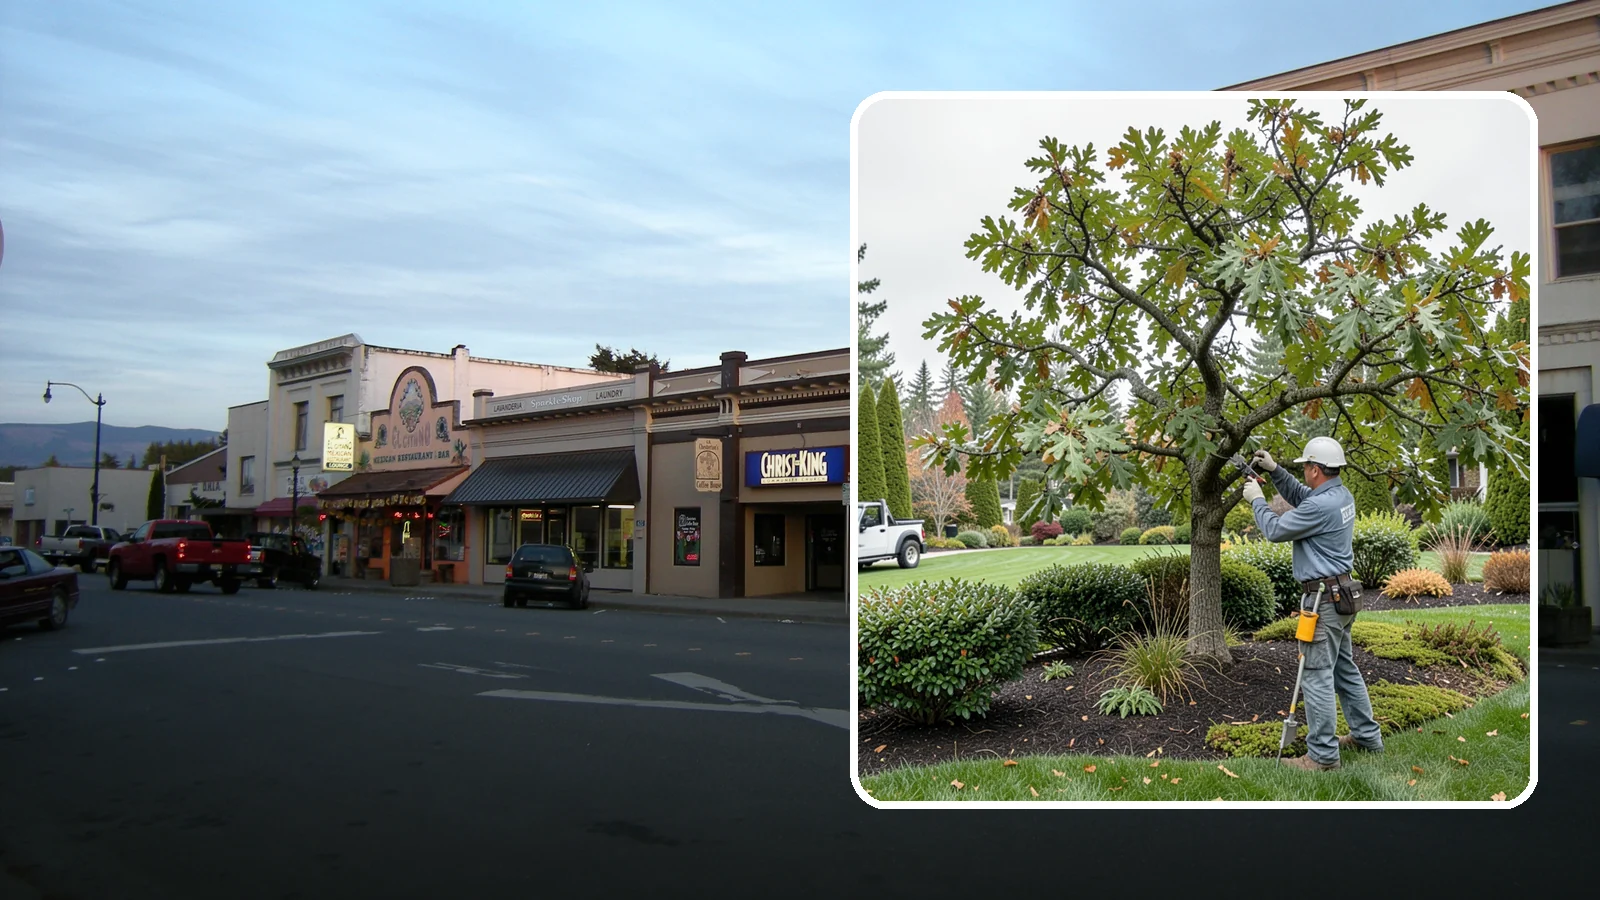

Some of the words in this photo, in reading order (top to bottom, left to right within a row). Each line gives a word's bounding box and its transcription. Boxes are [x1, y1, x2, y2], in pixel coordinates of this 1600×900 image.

[595, 388, 623, 399] LAUNDRY
[530, 397, 560, 409] Sparkle
[561, 394, 583, 405] Shop
[397, 451, 433, 462] RESTAURANT
[437, 450, 450, 459] BAR
[799, 450, 827, 476] KING
